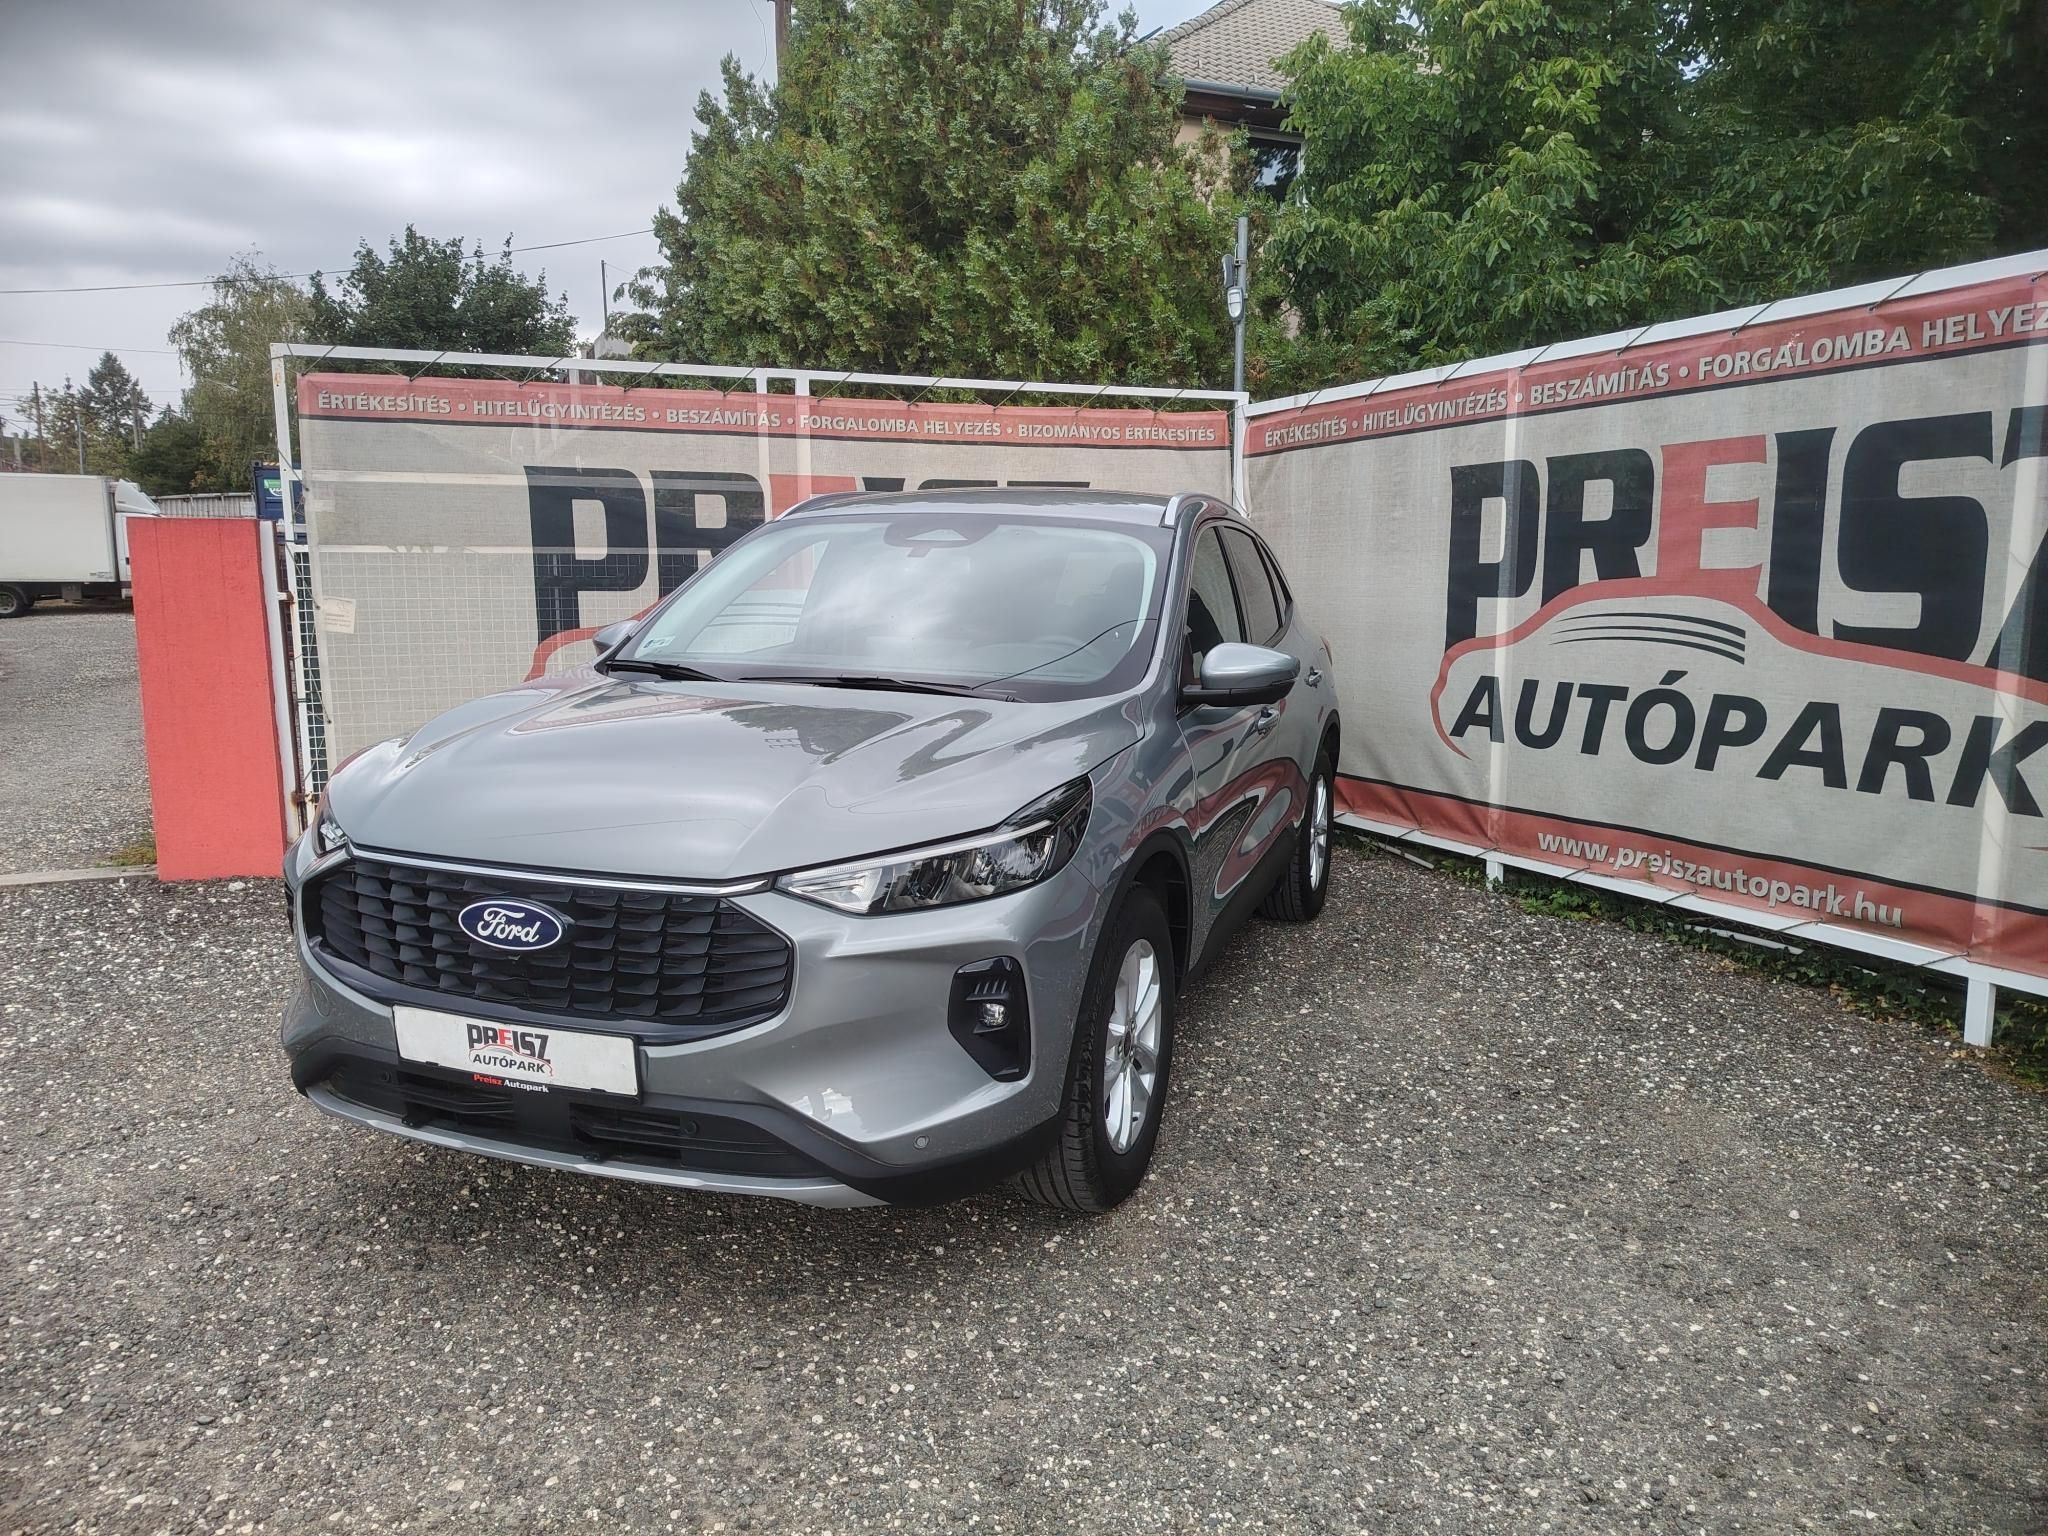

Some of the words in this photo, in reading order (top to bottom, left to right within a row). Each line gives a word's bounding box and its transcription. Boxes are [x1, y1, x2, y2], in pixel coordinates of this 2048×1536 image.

[1264, 417, 1348, 448] ÉRTÉKESÍTÉS
[1362, 389, 1508, 432] HITELÜGYINTÉZÉS
[1530, 363, 1671, 406] BESZÁMÍTÁS
[1699, 325, 1912, 381] FORGALOMBA
[317, 390, 452, 414] ÉRTÉKESÍTÉS
[472, 396, 647, 422] HITELÜGYINTÉZÉS
[666, 405, 781, 427] BESZÁMÍTÁS
[800, 414, 919, 434] FORGALOMBA
[923, 417, 1002, 436] HELYEZÉS
[1018, 421, 1121, 440] BIZOMÁNYOS
[1125, 423, 1216, 442] ÉRTÉKESÍTÉS
[1450, 670, 2048, 818] AUTÓPARK
[1537, 832, 1903, 928] www.preiszautopark.hu
[477, 907, 542, 943] Ford
[466, 1023, 551, 1064] PREISZ
[472, 1053, 546, 1074] AUTÓPARK
[473, 1073, 503, 1086] Preisz
[503, 1079, 549, 1093] Autopark
